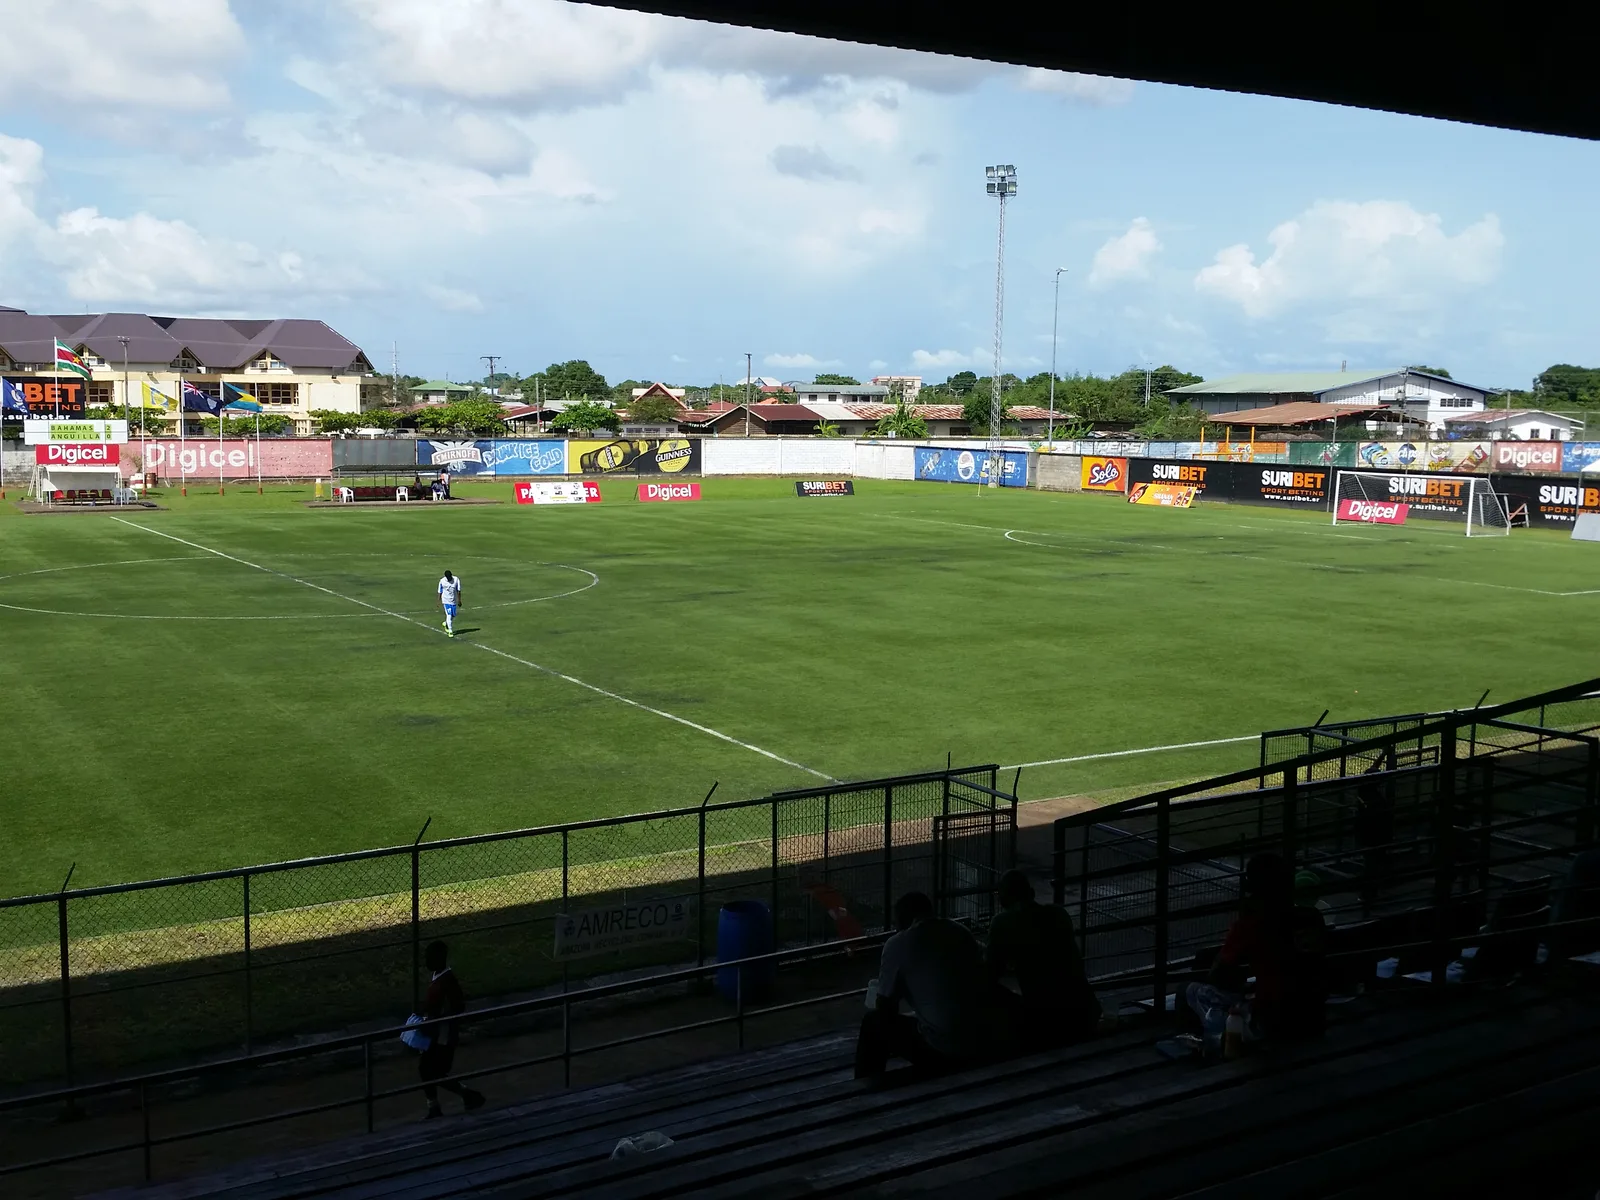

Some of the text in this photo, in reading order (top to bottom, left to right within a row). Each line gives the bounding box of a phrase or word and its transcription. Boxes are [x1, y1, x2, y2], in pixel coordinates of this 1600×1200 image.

[29, 403, 81, 411] ETTNG
[48, 444, 108, 463] Digicel
[145, 443, 254, 474] Digicel
[435, 449, 477, 463] SMIRNOFF
[519, 443, 540, 459] ICE
[530, 447, 563, 472] COLD
[655, 447, 693, 463] GUINNESS
[1499, 447, 1557, 468] Digicel
[1090, 463, 1120, 484] Solo
[1152, 464, 1207, 481] SURIBET
[1261, 470, 1325, 489] SURIBET
[648, 484, 692, 501] Digicel
[802, 481, 847, 490] SURIBET
[1260, 487, 1325, 497] SPORT BETTING
[1388, 477, 1464, 497] SURIBET
[1264, 494, 1320, 502] www.suribet.sr
[1421, 497, 1463, 506] BETTING
[1539, 485, 1600, 507] SURIB
[1348, 501, 1398, 521] Digicel
[1540, 506, 1575, 514] SPORT
[577, 904, 668, 938] AMRECO
